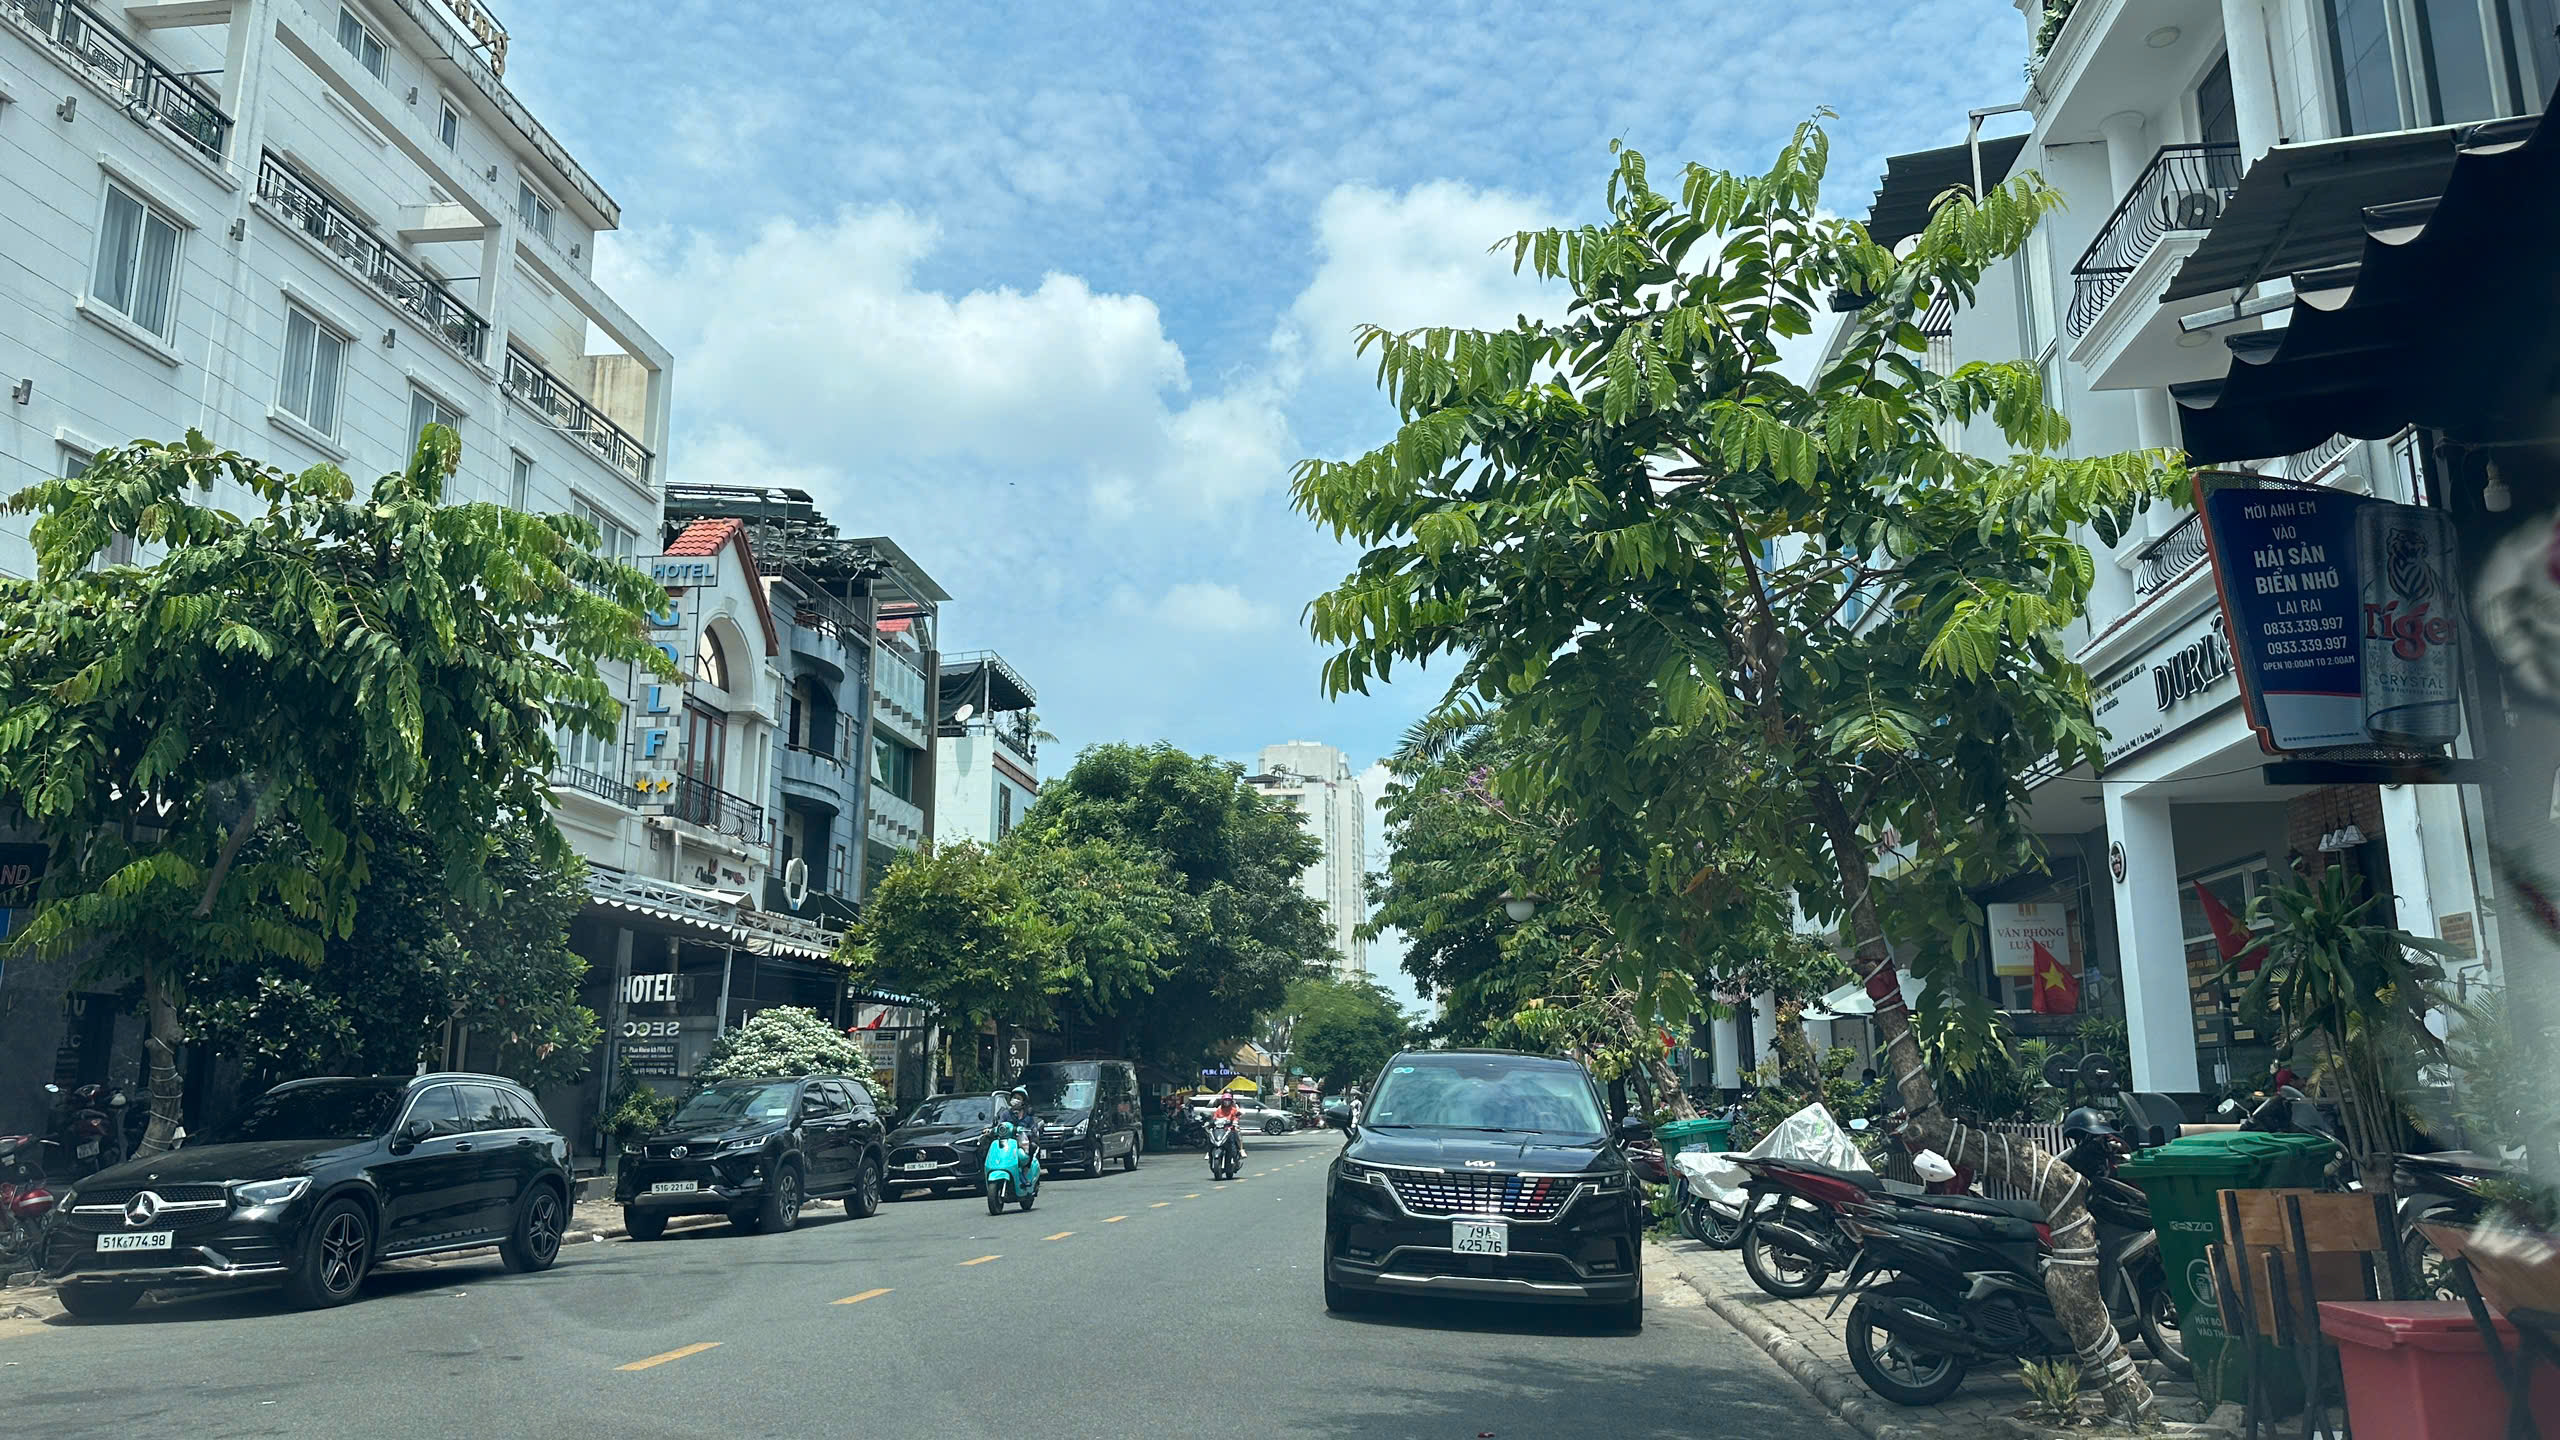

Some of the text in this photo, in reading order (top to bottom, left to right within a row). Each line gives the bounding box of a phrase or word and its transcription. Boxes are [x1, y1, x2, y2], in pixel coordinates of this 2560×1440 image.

[2244, 501, 2317, 519] MỜI ANH EM
[2272, 524, 2296, 540] VÀO
[2253, 541, 2326, 568] HẢI SẢN
[653, 563, 715, 579] HOTEL
[2255, 566, 2340, 594] BIỂN NHỚ
[2276, 598, 2322, 615] LAI RAI
[2263, 616, 2343, 636] 0833.339.997
[2267, 636, 2347, 655] 0933.339.997
[2263, 661, 2283, 671] OPEN
[2316, 658, 2326, 666] TO
[2379, 674, 2444, 689] CRYSTAL
[2009, 939, 2033, 951] LUẬ
[619, 973, 676, 1003] HOTEL
[1458, 1239, 1502, 1253] 425.76
